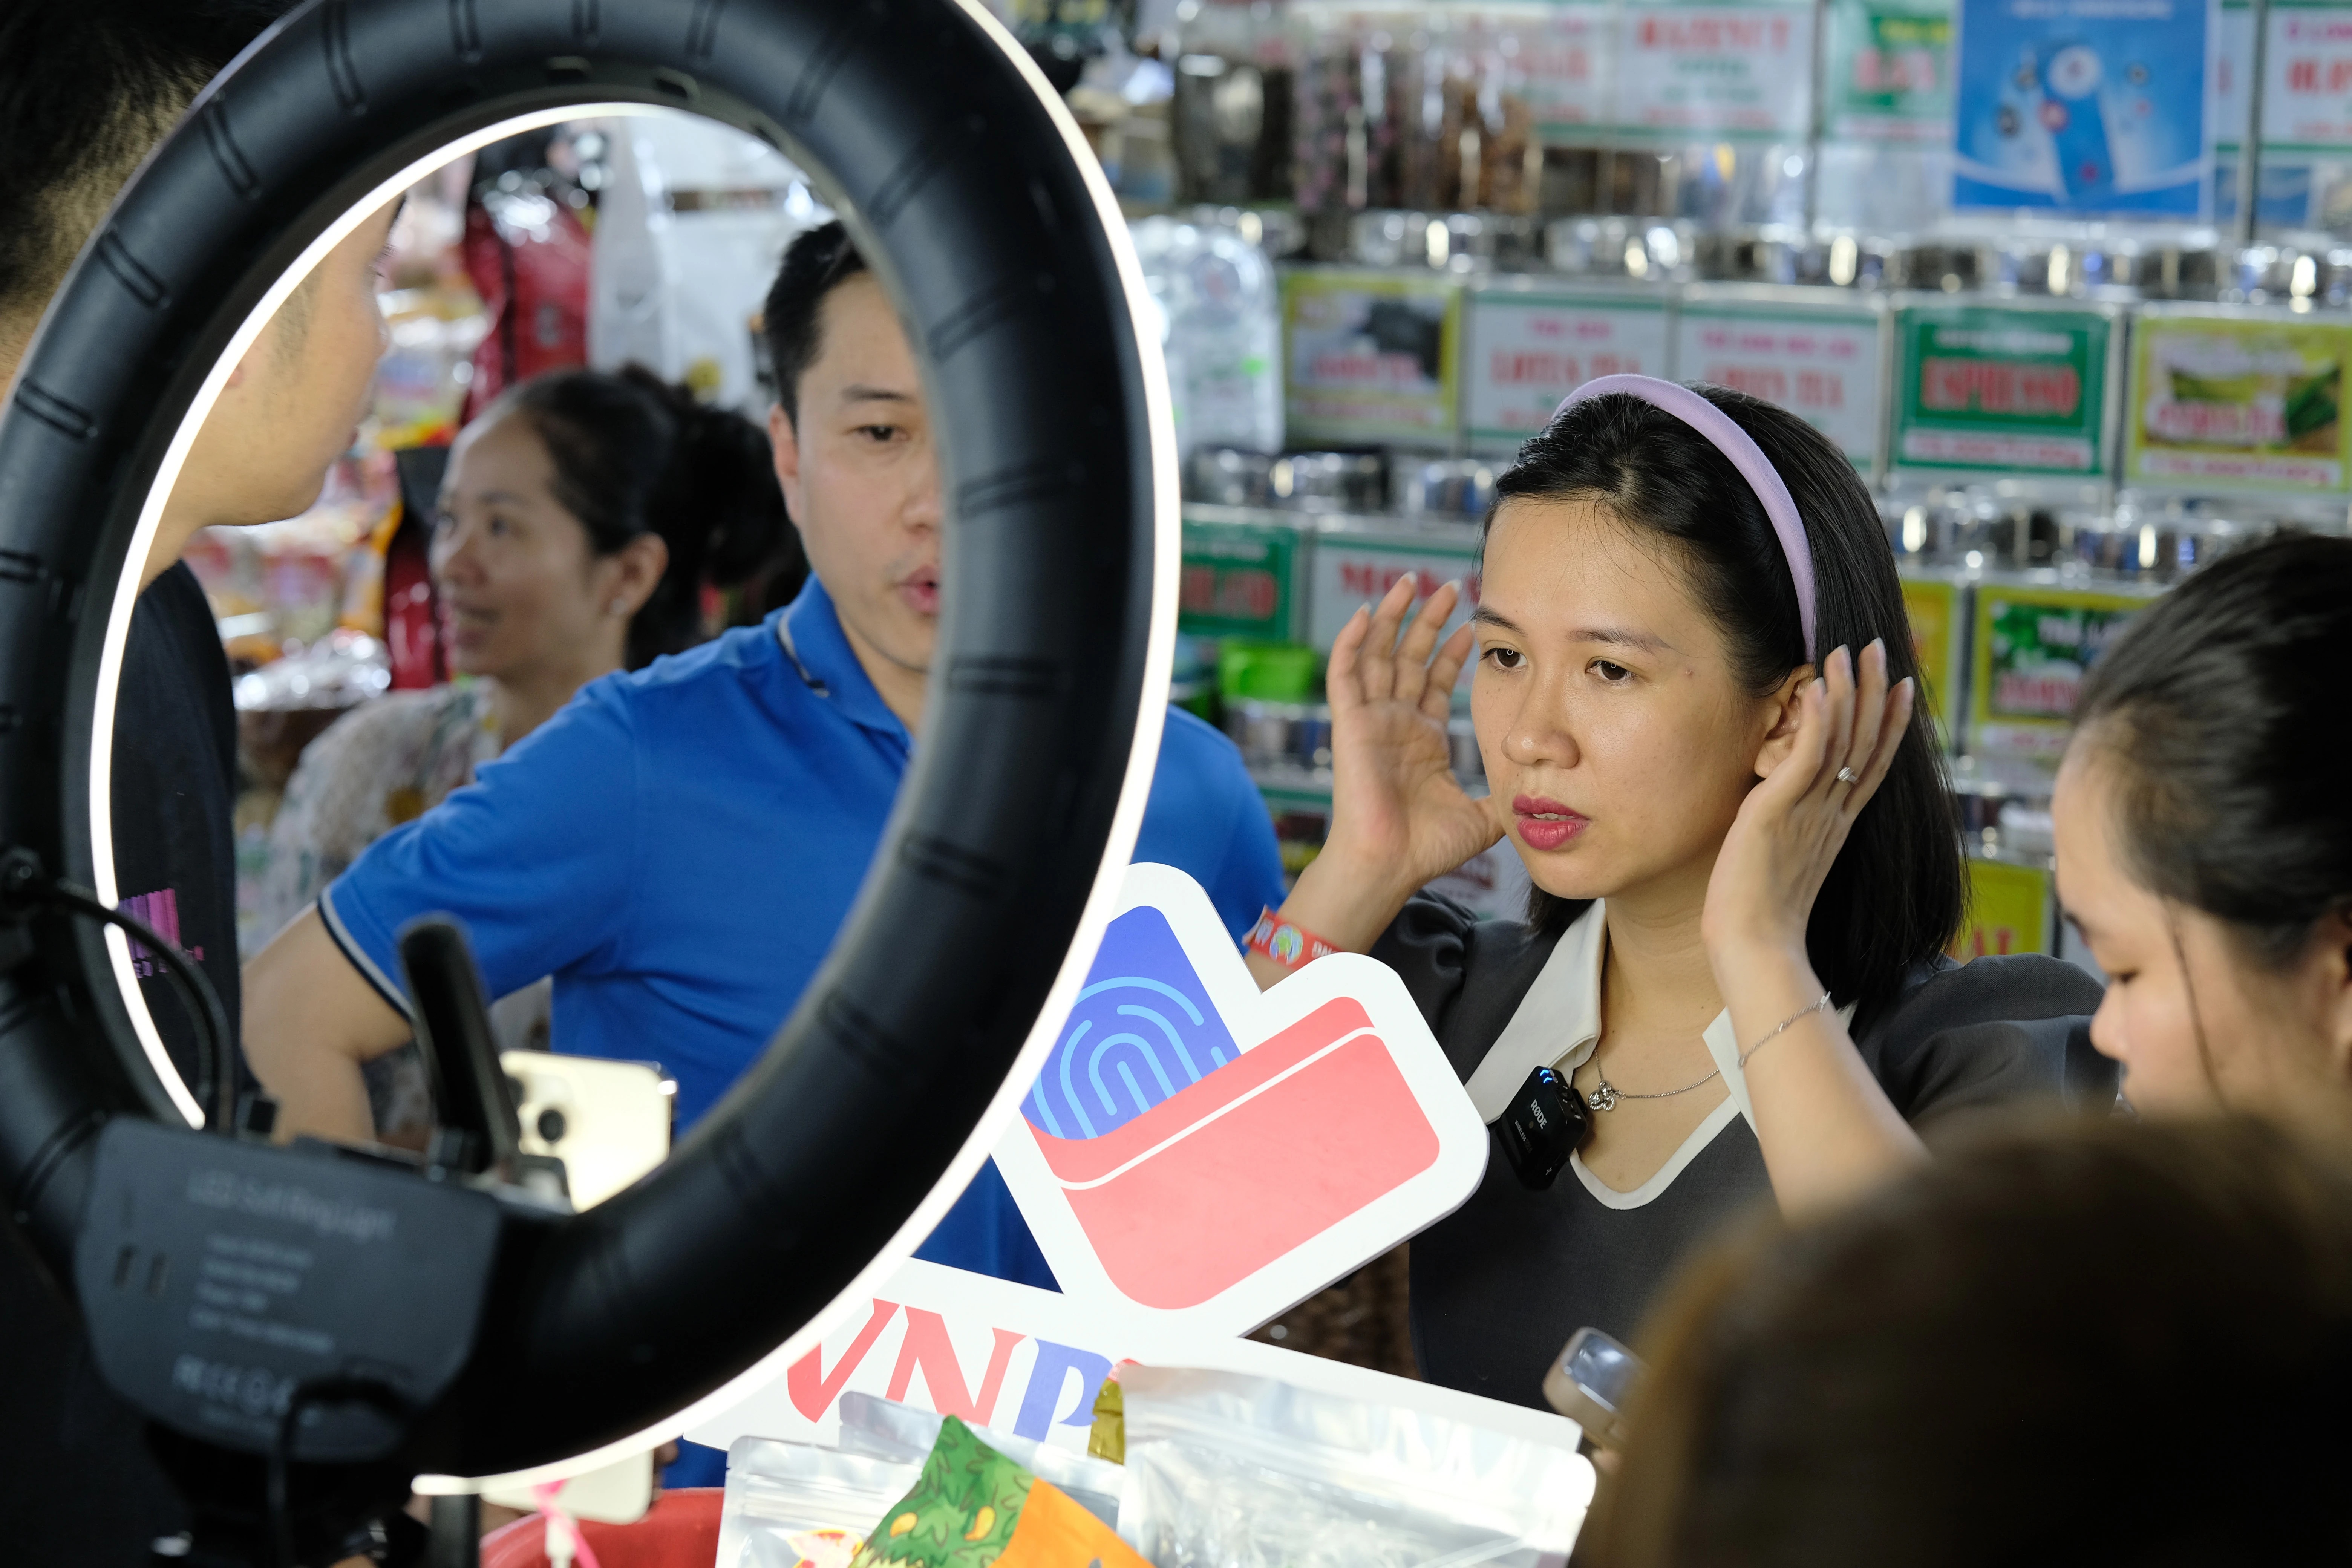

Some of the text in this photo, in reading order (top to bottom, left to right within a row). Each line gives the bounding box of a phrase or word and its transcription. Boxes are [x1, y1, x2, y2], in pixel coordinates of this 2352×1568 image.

[1920, 356, 2081, 417] ESPRESSO
[1530, 1099, 1547, 1130] RØDE
[1514, 1119, 1527, 1142] WIRELESS
